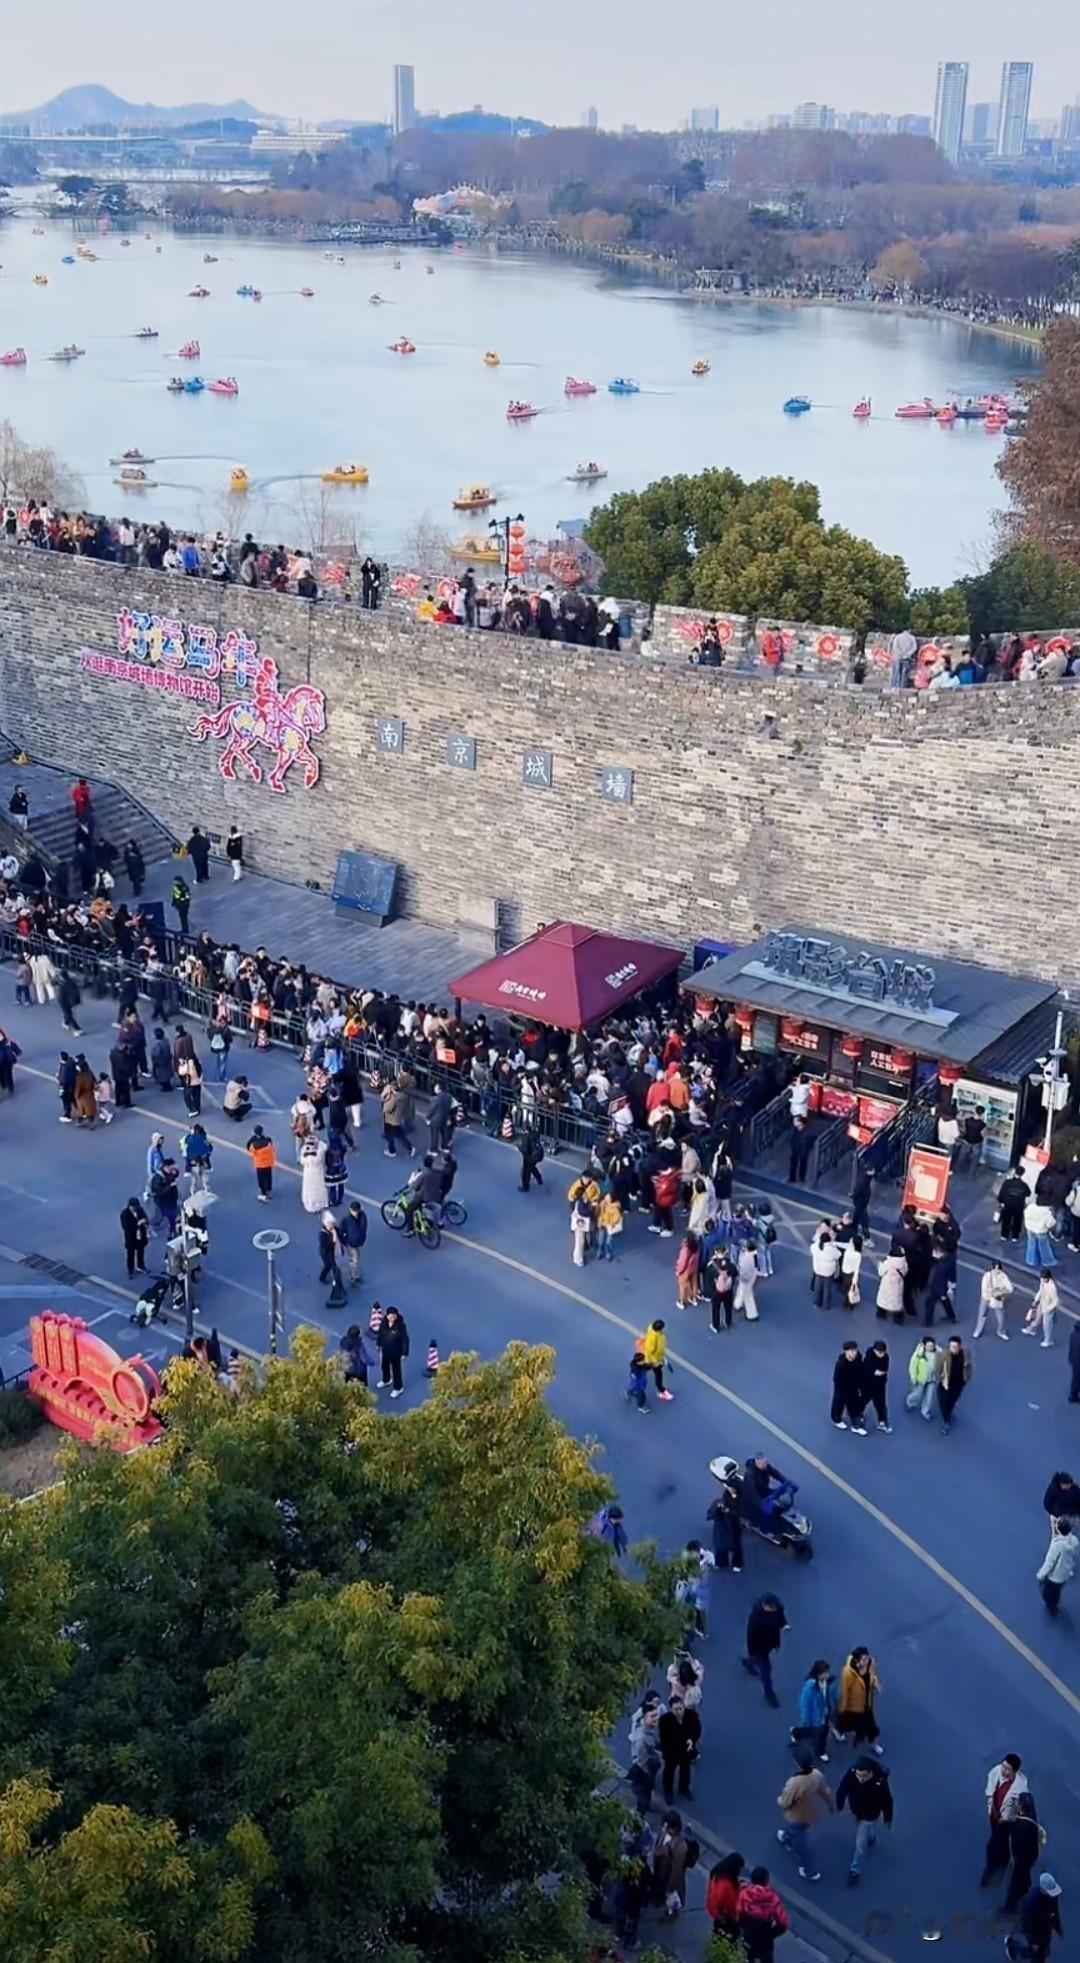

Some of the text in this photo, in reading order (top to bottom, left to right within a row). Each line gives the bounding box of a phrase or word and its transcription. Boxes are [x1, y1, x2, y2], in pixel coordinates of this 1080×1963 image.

[80, 650, 221, 704] 从逛南京城墙博物馆开始
[117, 606, 259, 687] 好运马年
[380, 723, 628, 799] 南京城墙
